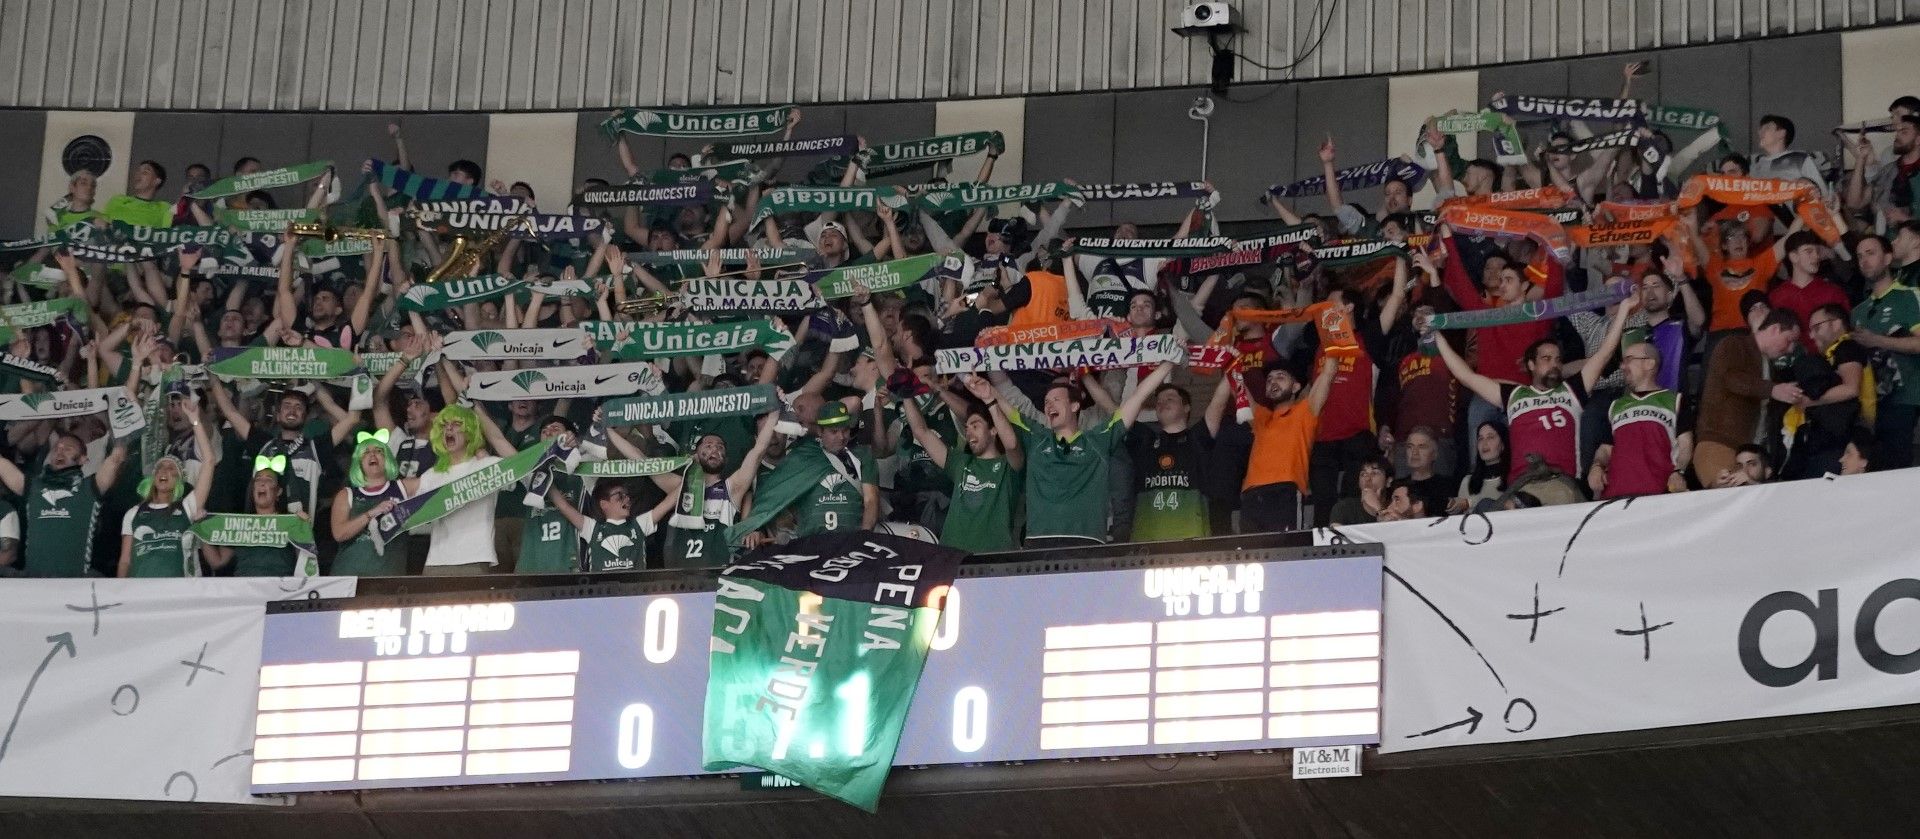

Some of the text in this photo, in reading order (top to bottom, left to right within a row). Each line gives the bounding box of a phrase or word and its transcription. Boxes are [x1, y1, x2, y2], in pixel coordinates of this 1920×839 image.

[1517, 95, 1637, 119] UNICAJA
[668, 113, 760, 133] Unicaja
[731, 137, 844, 155] UNICAJA BALONCESTO
[884, 136, 977, 161] Unicaja
[584, 190, 627, 203] UNICAJA
[628, 185, 697, 202] BALONCESTO
[961, 182, 1057, 203] Unicaja
[1078, 182, 1178, 200] NICAJA
[1706, 178, 1772, 193] VALENCIA
[771, 189, 874, 208] Unicaja
[1491, 187, 1541, 203] basket
[448, 212, 575, 233] UNICAJA
[1464, 211, 1508, 232] basket
[133, 225, 231, 245] Unicaja
[1080, 237, 1109, 248] CLUB
[1112, 237, 1168, 248] JOVENTUT
[1588, 228, 1652, 244] Esfuerzo
[843, 264, 889, 281] UNICAJA
[688, 280, 803, 297] UNICAJA
[833, 273, 900, 294] BALNCESTO
[721, 297, 799, 309] MALAGA
[1096, 292, 1125, 302] málaga
[1097, 306, 1114, 318] 14
[643, 325, 758, 350] Unicaja
[1012, 325, 1059, 344] basket
[263, 348, 316, 361] UNICAJA
[503, 343, 544, 355] Unicaja
[993, 337, 1122, 358] UNICAJA
[251, 361, 327, 375] BALONCESTO
[1035, 352, 1119, 370] MALAGA
[545, 381, 586, 393] Unicaja
[53, 400, 94, 412] Unicaja
[624, 400, 674, 421] UNICAJA
[678, 392, 751, 417] BALONCESTO
[1539, 411, 1567, 430] 15
[1632, 409, 1673, 427] RONDA
[593, 460, 675, 474] BALONCESTO
[452, 464, 502, 494] UNICAJA
[1145, 474, 1190, 489] PROBITAS
[444, 468, 515, 511] BALONCESTO
[818, 493, 847, 503] Unicaja
[1153, 491, 1179, 511] 44
[40, 508, 70, 516] Unicaja
[825, 511, 838, 530] 9
[224, 518, 277, 531] UNICAJA
[541, 522, 561, 541] 12
[210, 530, 289, 544] BALONCESTO
[686, 539, 703, 558] 22
[604, 558, 634, 568] Unicaja
[1144, 563, 1264, 598] UNICAJA
[867, 564, 923, 651] PEÑA
[338, 602, 515, 639] REAL MADRID
[643, 597, 679, 664] 0
[755, 612, 834, 720] VERDE
[952, 685, 989, 753] 0
[617, 702, 654, 769] 0
[1298, 748, 1350, 765] M&M
[1297, 765, 1350, 775] Electronics
